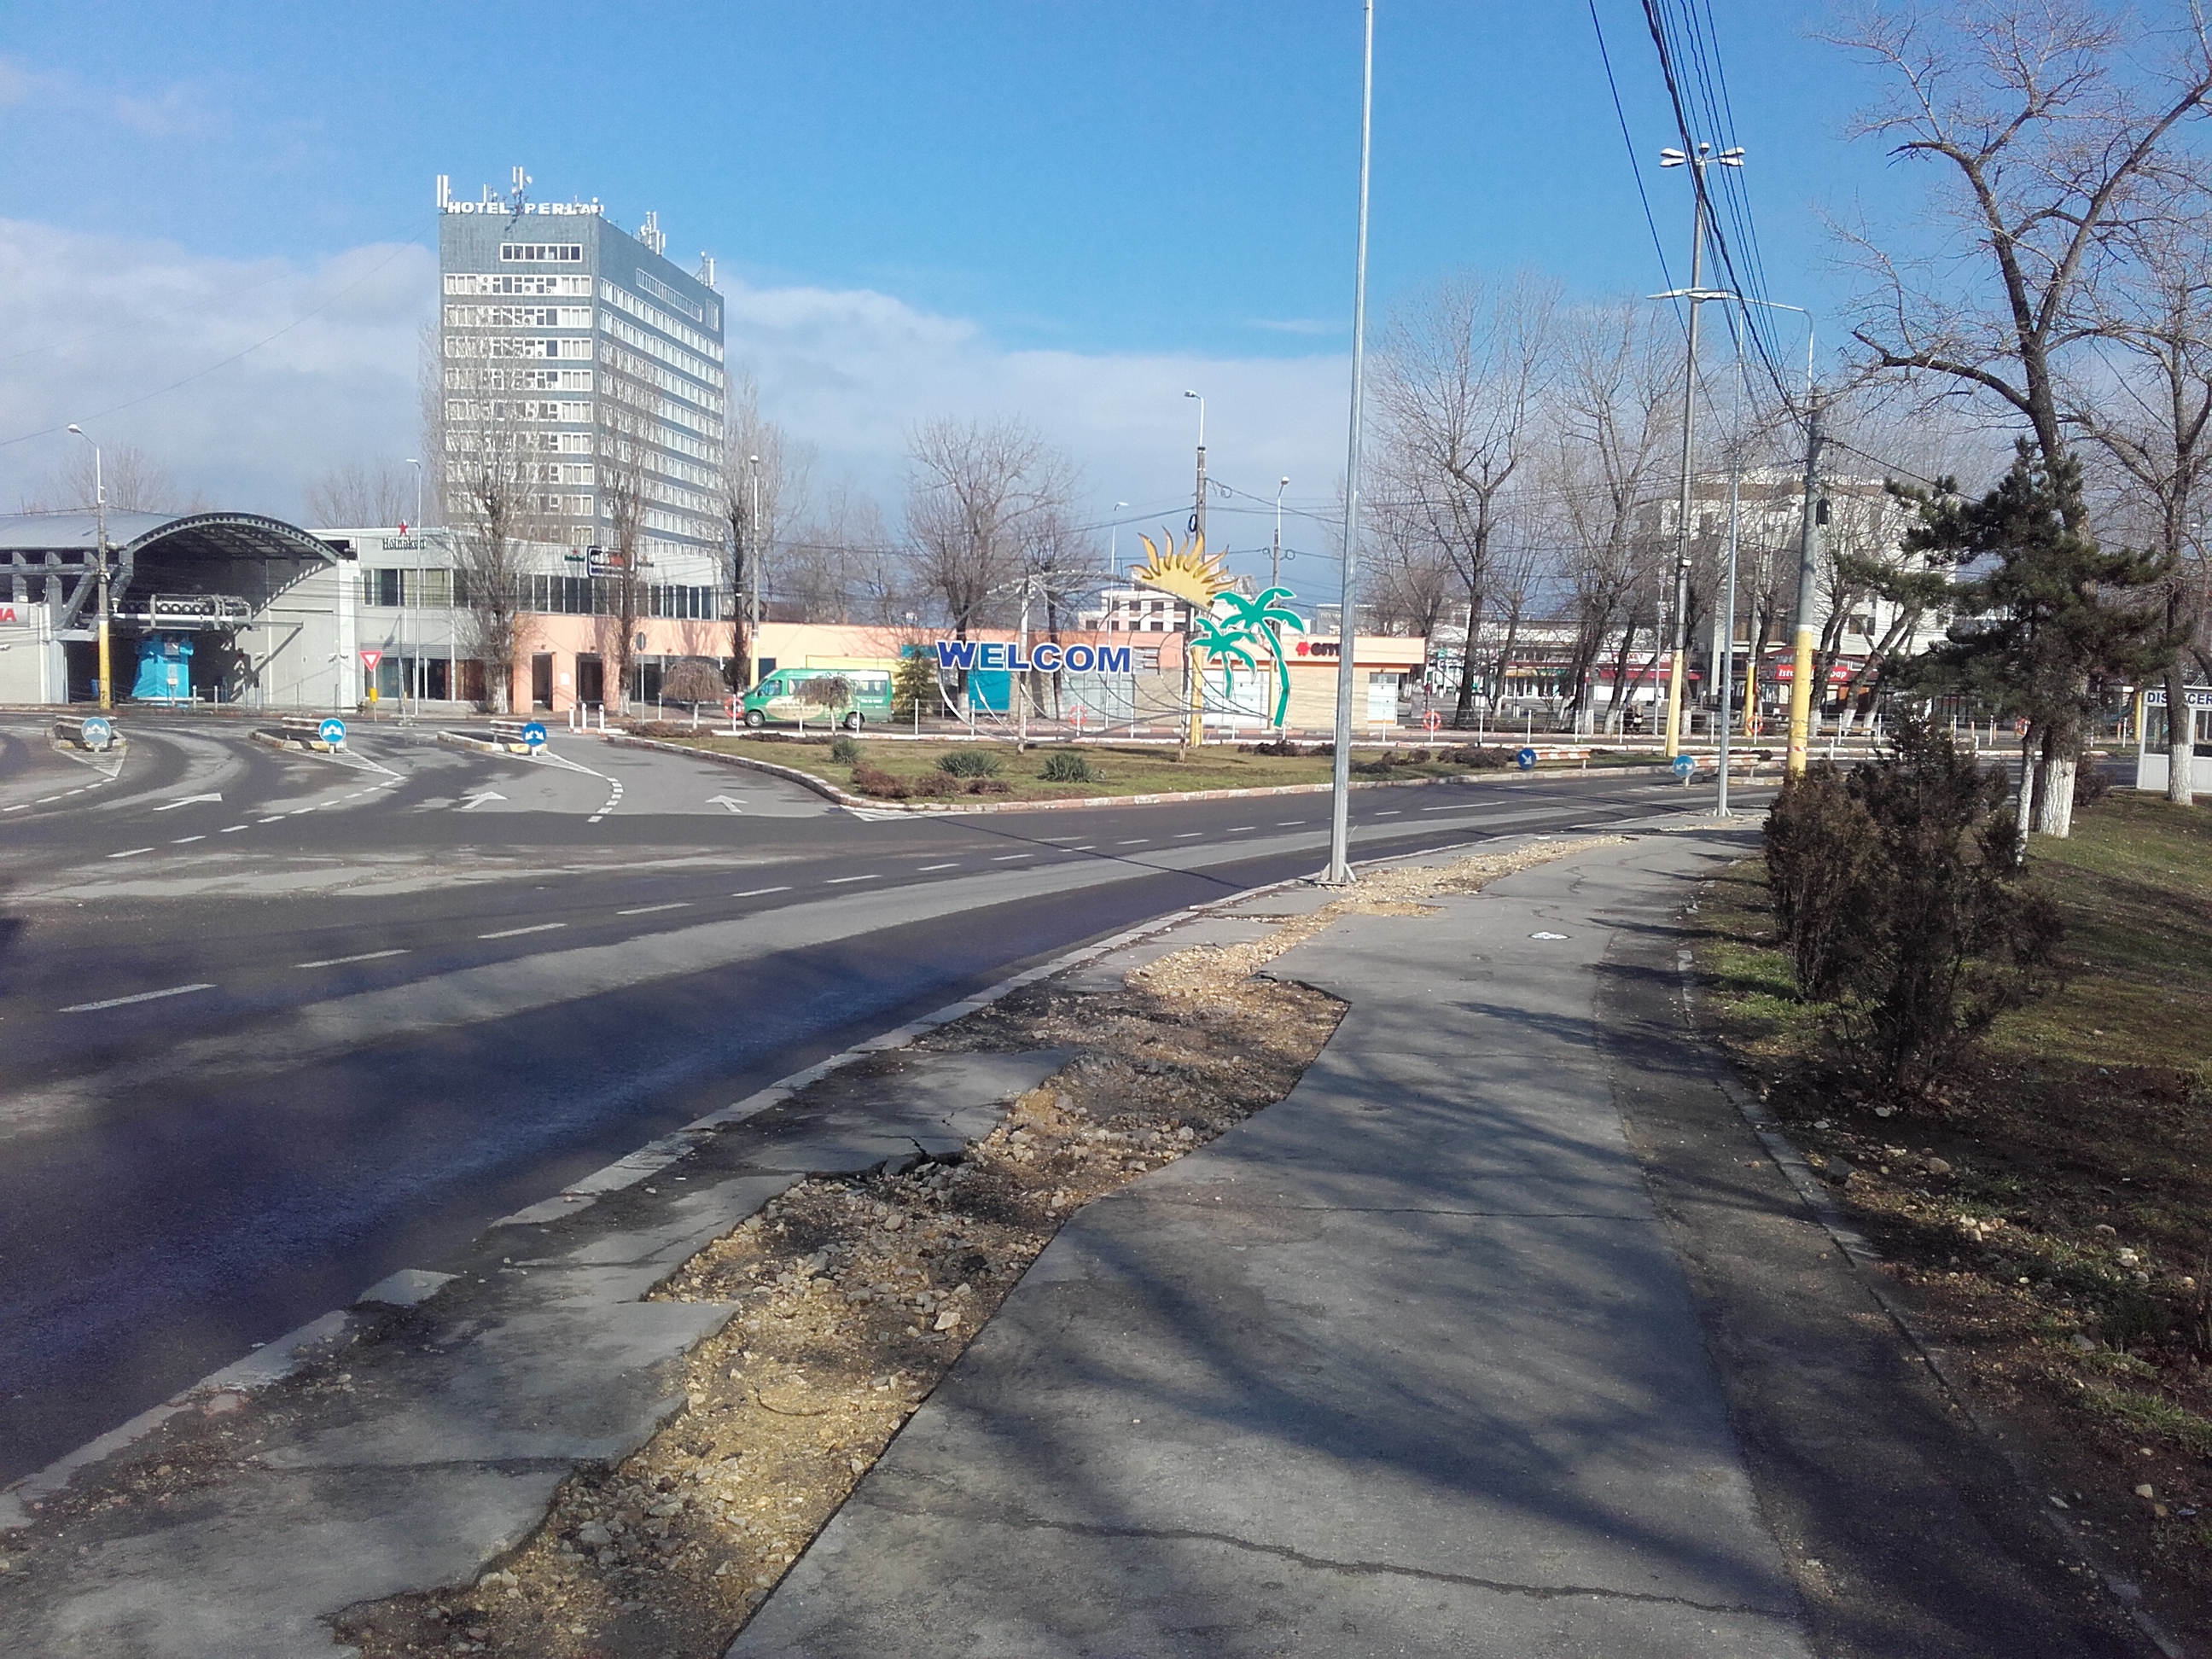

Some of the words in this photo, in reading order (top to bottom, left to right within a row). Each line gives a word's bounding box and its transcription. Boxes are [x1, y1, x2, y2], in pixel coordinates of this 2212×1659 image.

[447, 201, 510, 214] HOTEL
[524, 202, 591, 215] PERLA
[382, 535, 426, 550] Heineken
[936, 640, 1132, 675] WELCOM
[2147, 692, 2212, 705] DISCER
